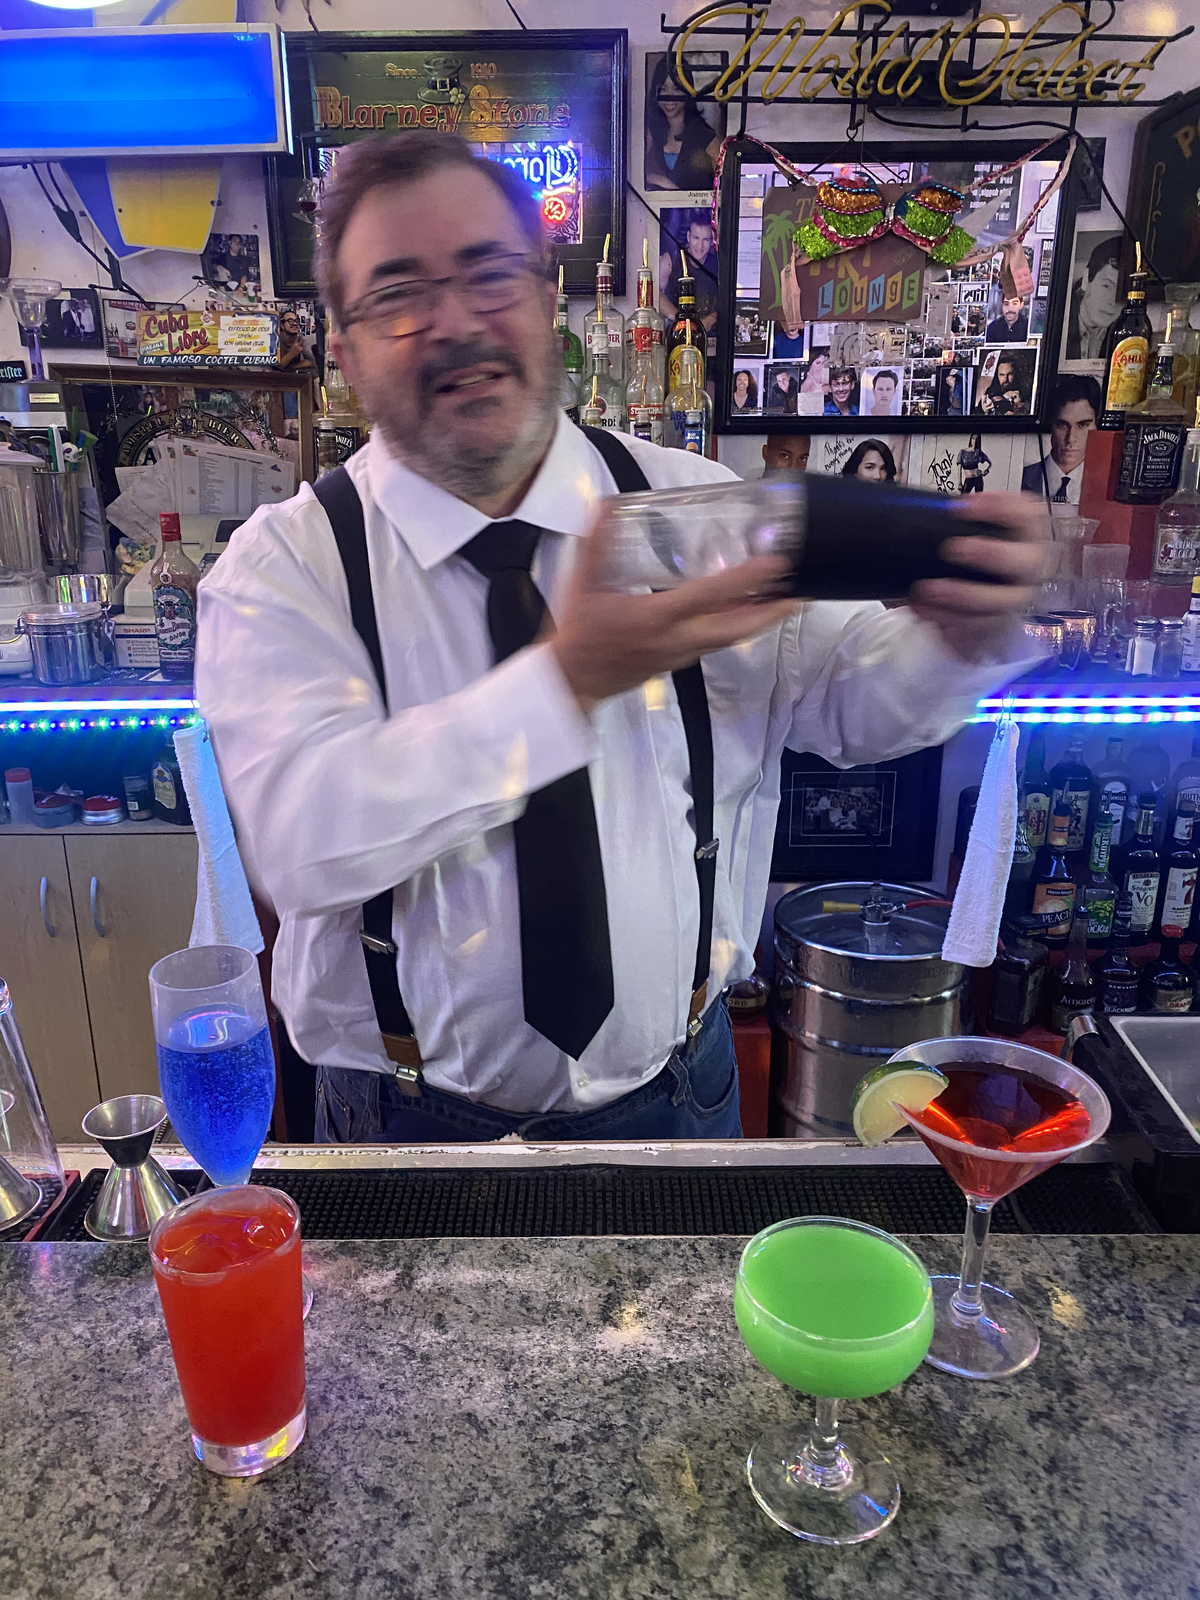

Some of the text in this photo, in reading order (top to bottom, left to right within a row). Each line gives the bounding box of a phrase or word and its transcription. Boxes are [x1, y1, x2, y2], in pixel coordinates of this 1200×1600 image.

[314, 84, 571, 133] Blarney Stone
[144, 311, 189, 338] Cuba
[168, 327, 207, 354] Libre
[143, 355, 278, 365] UN FAMOSO COCTEL CUBANO
[121, 416, 166, 457] AMSTEL
[206, 418, 241, 445] BIER
[1182, 876, 1197, 905] 7
